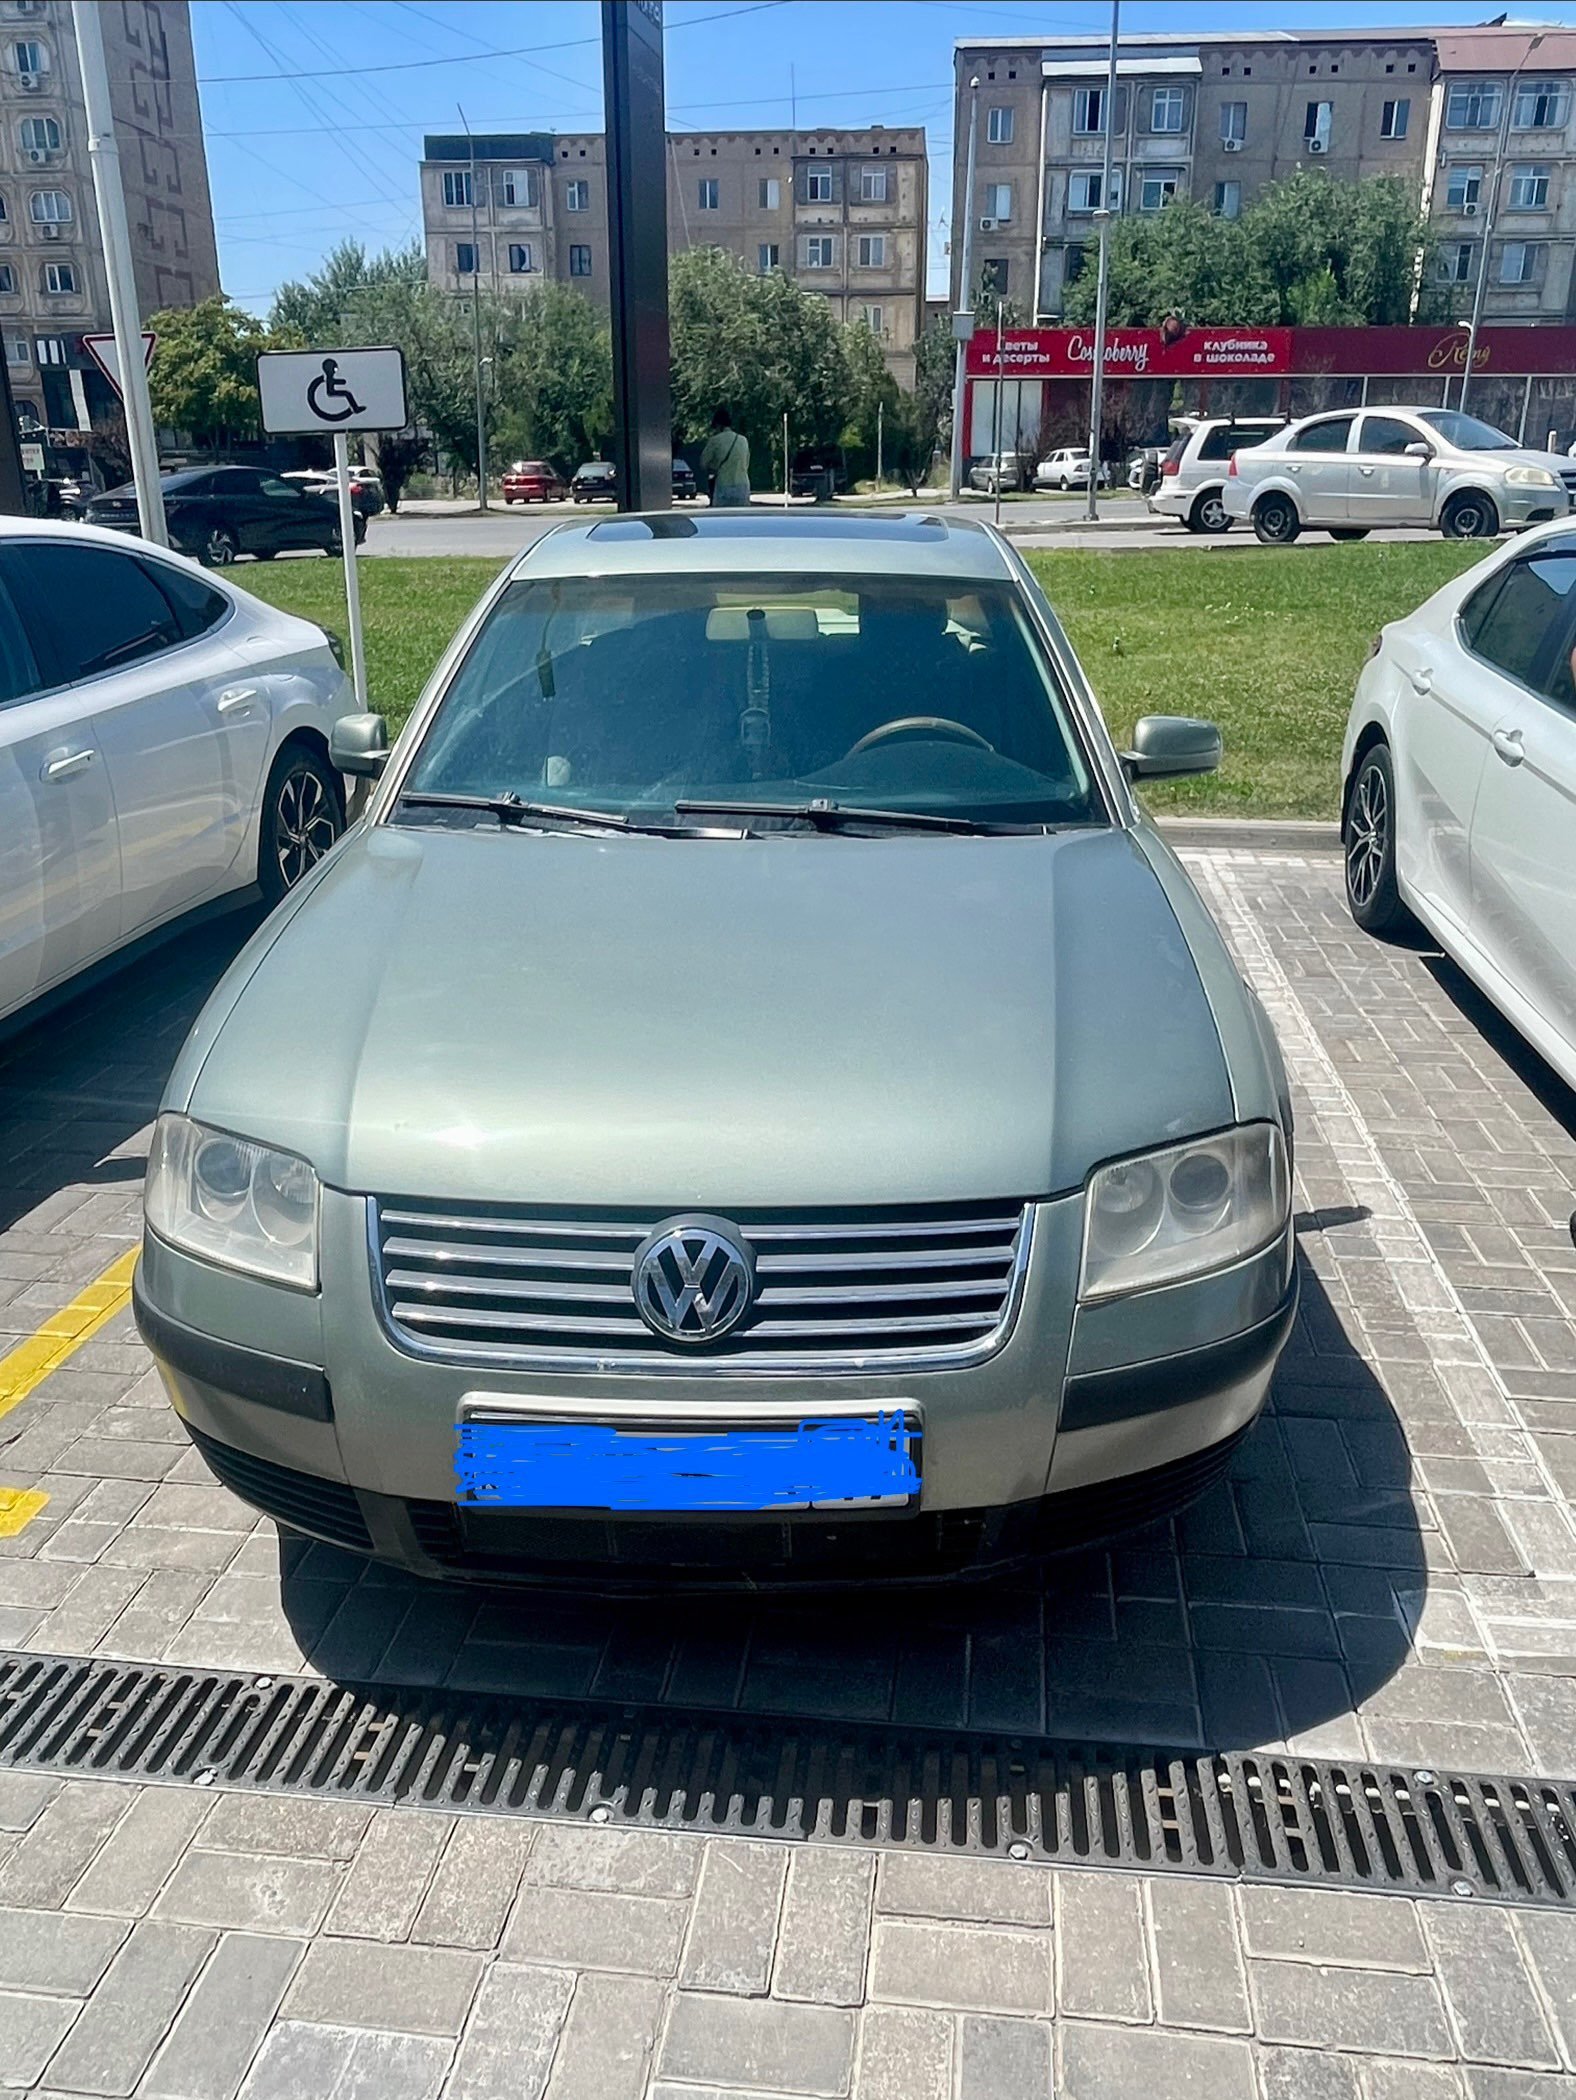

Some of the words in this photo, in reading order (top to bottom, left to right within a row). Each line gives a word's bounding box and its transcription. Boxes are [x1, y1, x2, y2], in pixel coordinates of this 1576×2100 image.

[997, 342, 1038, 351] веты
[1203, 339, 1268, 352] клубника
[982, 354, 990, 363] и
[1068, 335, 1149, 371] Cosoberry
[1193, 353, 1202, 363] в
[1206, 353, 1275, 364] шоколаде
